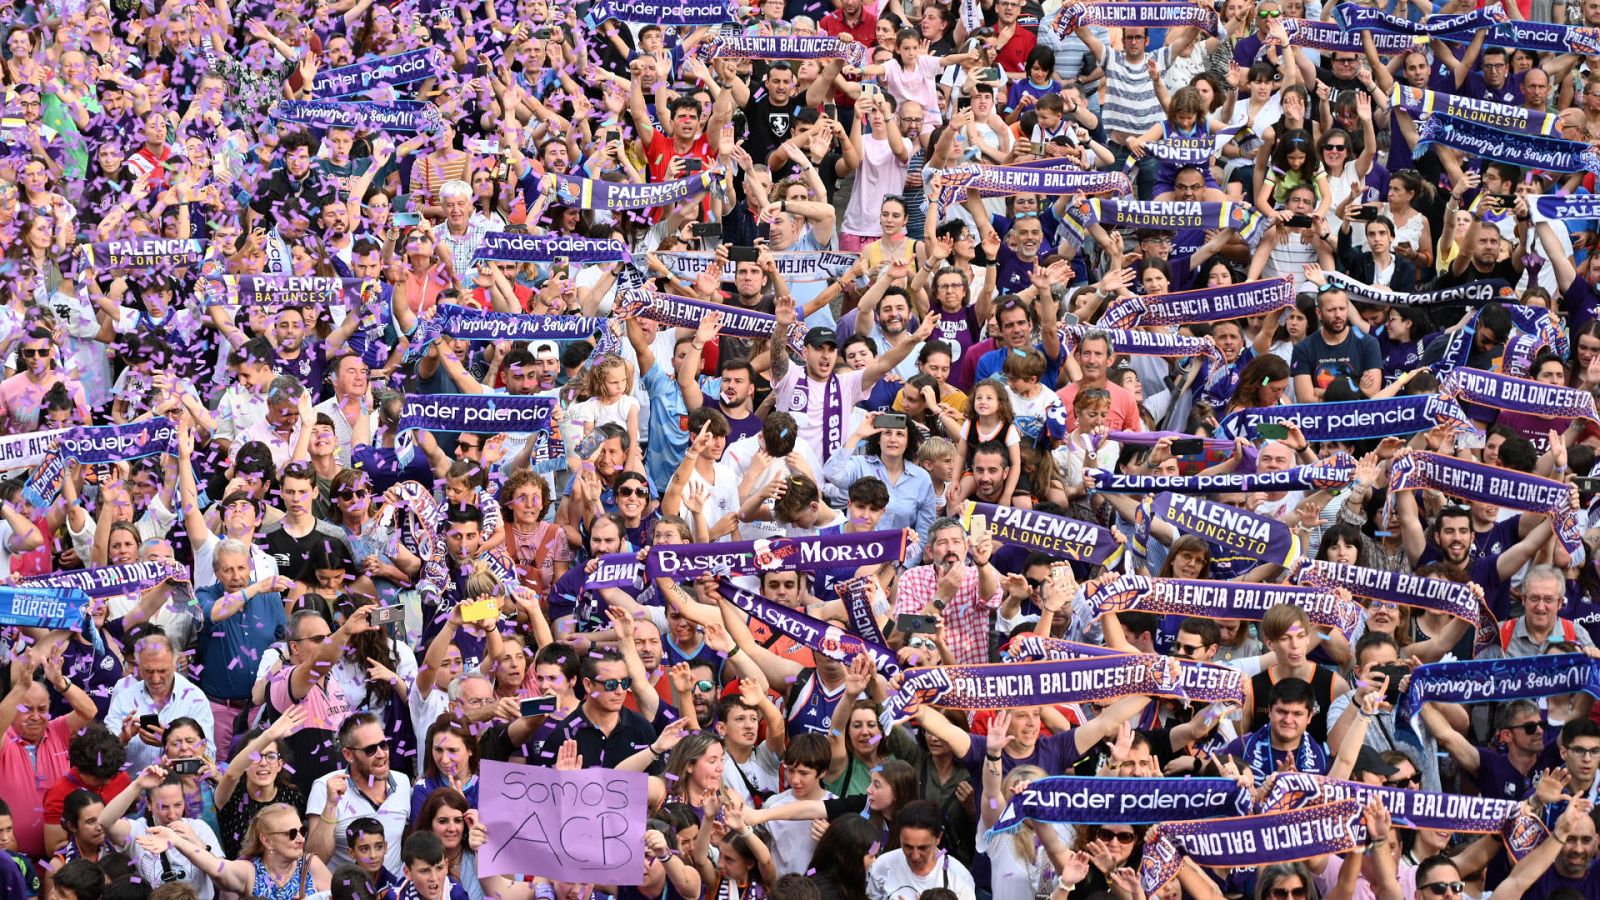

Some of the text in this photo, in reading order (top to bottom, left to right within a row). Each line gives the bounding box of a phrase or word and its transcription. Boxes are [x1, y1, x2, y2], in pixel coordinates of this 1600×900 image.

[609, 1, 722, 18] zunder palencia
[1088, 5, 1205, 21] PALENCIA BALONCESTO
[1356, 8, 1412, 30] zunder
[1413, 9, 1478, 32] palencia
[727, 38, 776, 53] PALENCIA
[1301, 25, 1350, 46] PALENCIA
[312, 69, 359, 93] under
[1448, 106, 1527, 130] BALONCESTO
[1449, 95, 1529, 119] PALENCIA
[606, 179, 689, 199] PALENCIA
[984, 169, 1119, 190] PALENCIA BALONCESTO
[606, 187, 689, 208] BALONCESTO
[1117, 200, 1203, 216] PALENCIA
[1117, 213, 1202, 226] BALONCESTO
[109, 239, 196, 256] PALENCIA
[485, 237, 624, 255] under palencia
[252, 276, 343, 292] PALENCIA
[1408, 284, 1494, 304] PALENCIA
[1150, 284, 1292, 318] PALENCIA BALONCESTO
[1501, 381, 1592, 409] BALONCESTO
[400, 400, 550, 424] under palencia
[1327, 403, 1416, 432] palencia
[1112, 472, 1290, 490] zunder palencia
[1416, 461, 1483, 491] PALENCIA
[992, 505, 1099, 545] PALENCIA
[1170, 492, 1271, 543] PALENCIA
[989, 521, 1094, 557] BALONCESTO
[1166, 507, 1268, 555] BALONCESTO
[658, 550, 749, 573] BASKET
[800, 541, 884, 564] MORAO
[1317, 560, 1392, 591] PALENCIA
[1086, 574, 1146, 615] PALENCIA
[1154, 582, 1229, 609] PALENCIA
[11, 598, 66, 619] BURGOS
[733, 588, 820, 644] BASKET
[887, 669, 945, 716] PALENCIA
[955, 673, 1033, 698] PALENCIA
[1039, 665, 1146, 694] BALONCESTO
[1022, 788, 1228, 814] zunder palencia
[492, 811, 633, 870] ACB
[1260, 814, 1344, 850] PALENCIA
